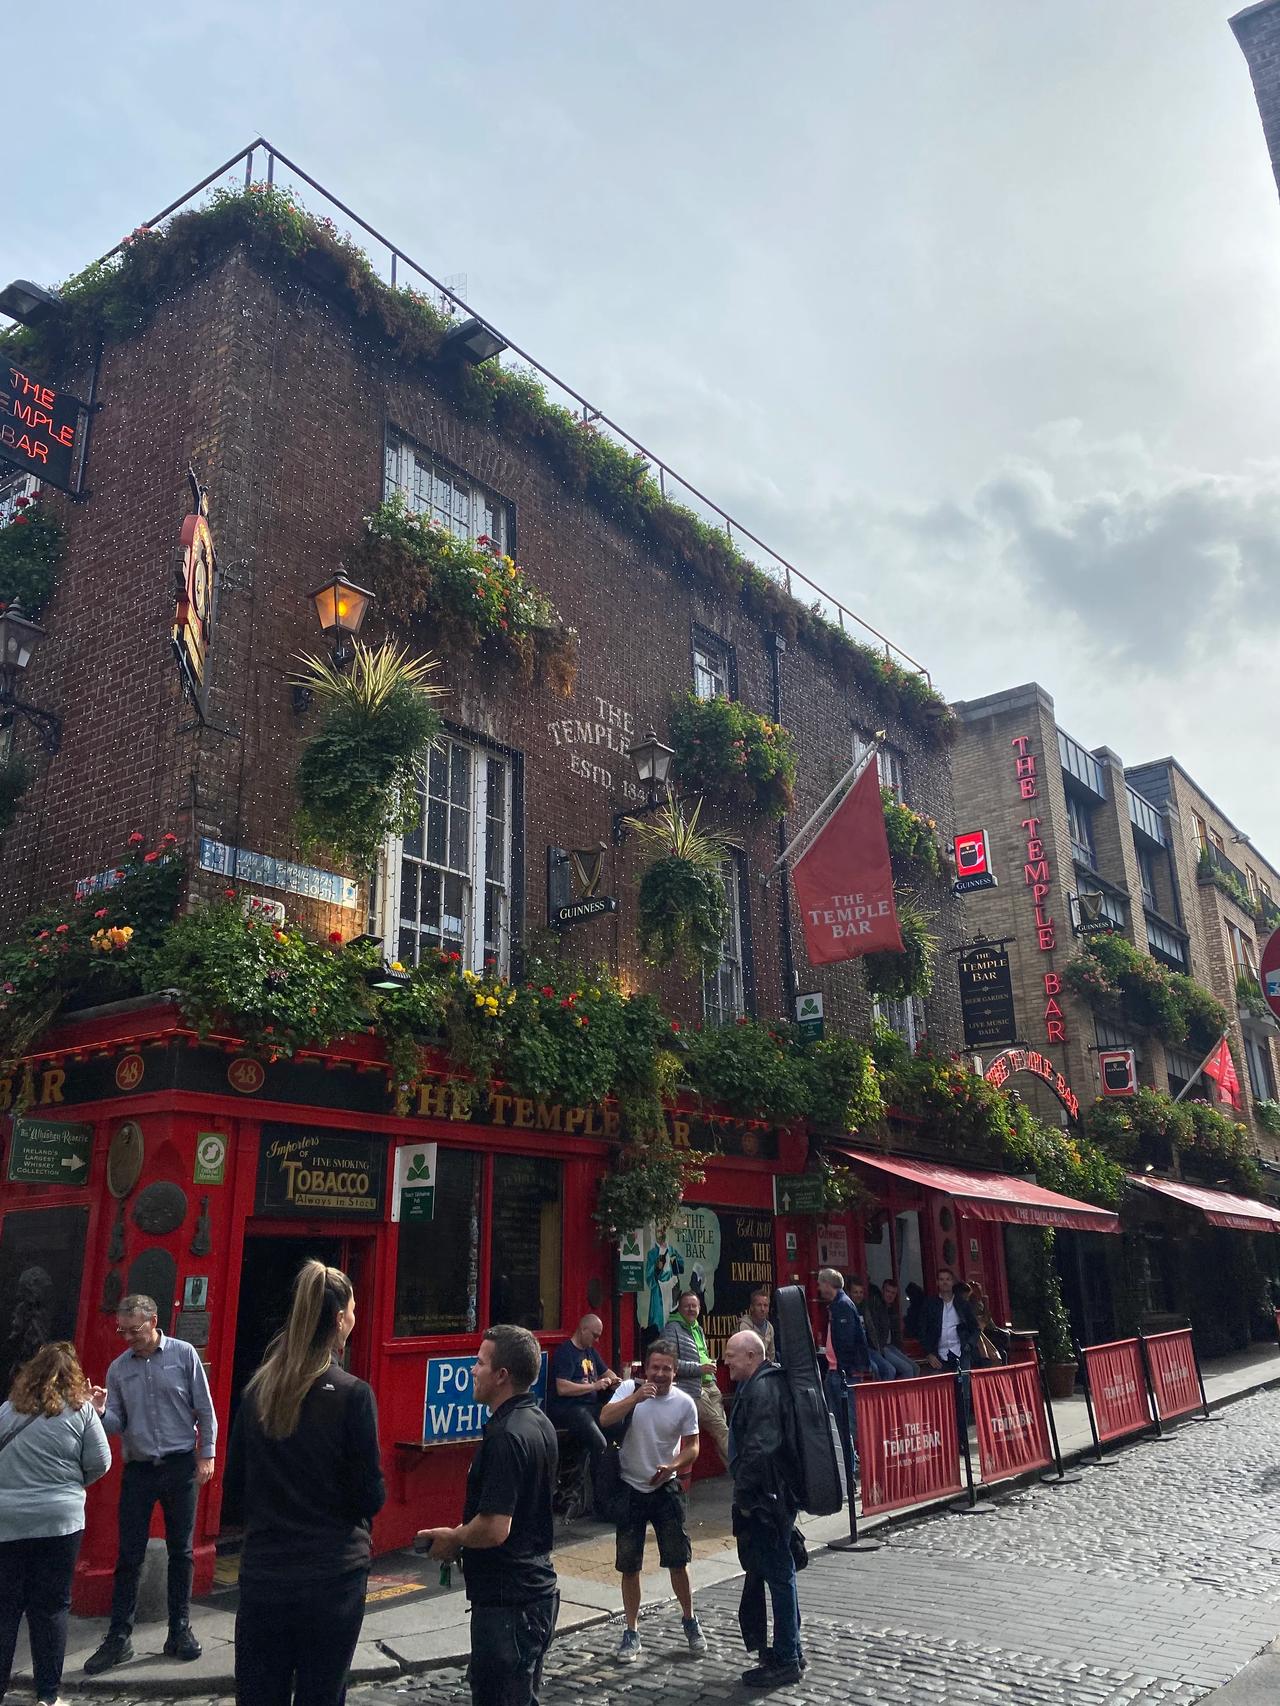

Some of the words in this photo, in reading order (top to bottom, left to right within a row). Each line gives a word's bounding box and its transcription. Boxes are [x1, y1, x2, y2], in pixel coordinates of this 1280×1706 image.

[9, 367, 56, 410] THE
[0, 391, 75, 447] EMPLE
[1, 424, 49, 464] BAR
[596, 697, 634, 735] THE
[547, 718, 631, 759] TEMPLE
[1011, 735, 1037, 800] THE
[304, 884, 337, 899] SOUTH
[956, 878, 991, 890] GUINNESS
[1021, 817, 1056, 950] TEMPLE
[831, 893, 865, 907] THE
[560, 901, 605, 919] GUINNESS
[808, 901, 891, 926] TEMPLE
[831, 921, 873, 938] BAR
[1078, 922, 1109, 931] GUINNESS
[976, 952, 991, 960] THE
[961, 959, 1008, 972] TEMPLE
[972, 971, 997, 982] BAR
[1044, 973, 1066, 1043] BAR
[121, 1061, 138, 1084] 48
[1055, 1072, 1079, 1120] BAR
[488, 1092, 621, 1138] TEMPLE
[23, 1147, 59, 1156] IRELAND'S
[266, 1136, 320, 1161] Importers
[23, 1161, 55, 1169] WHISKEY
[25, 1154, 55, 1162] LARGEST
[312, 1157, 332, 1168] FINE
[333, 1159, 370, 1170] SMOKING
[16, 1167, 60, 1176] COLLECTION
[279, 1161, 369, 1200] TOBACCO
[297, 1195, 332, 1206] Always
[348, 1198, 376, 1208] Stock
[686, 1213, 705, 1229] THE
[676, 1228, 715, 1245] TEMPLE
[685, 1244, 707, 1260] BAR
[752, 1242, 771, 1262] THE
[731, 1262, 772, 1282] EMPEROR
[1019, 1411, 1034, 1427] BR
[905, 1423, 920, 1436] THE
[883, 1436, 922, 1458] TEMPLE
[922, 1431, 942, 1449] BAR
